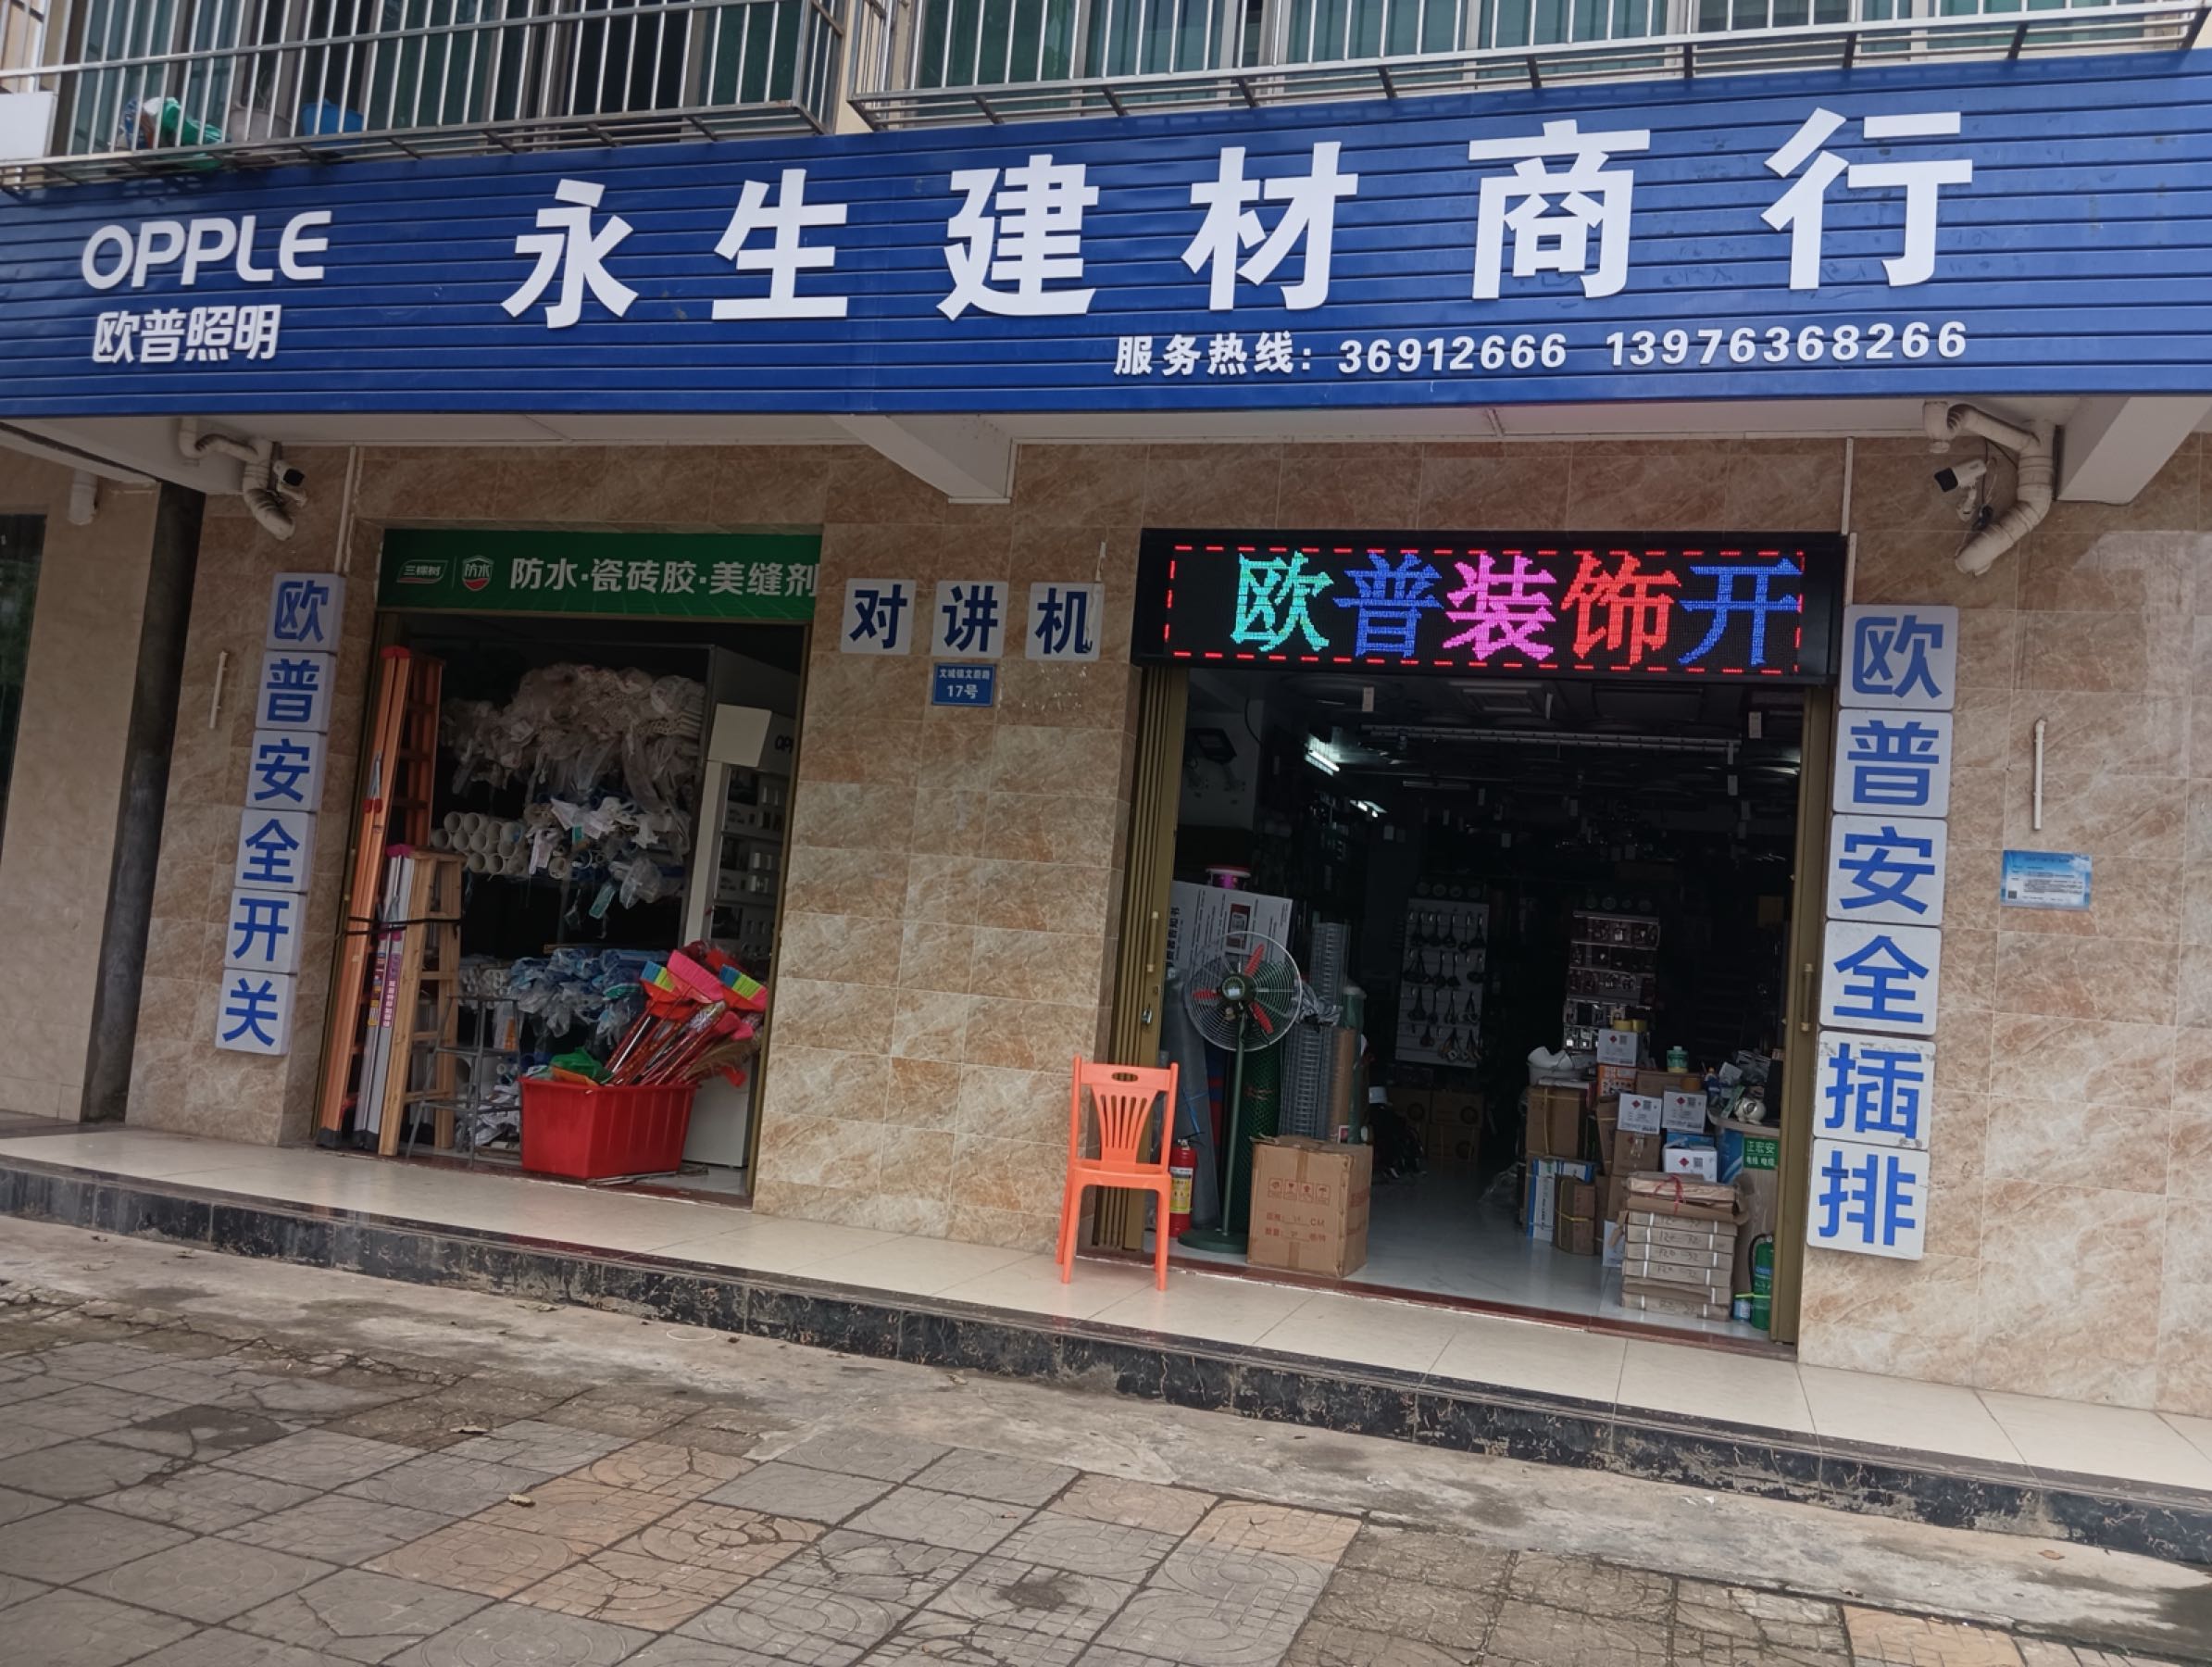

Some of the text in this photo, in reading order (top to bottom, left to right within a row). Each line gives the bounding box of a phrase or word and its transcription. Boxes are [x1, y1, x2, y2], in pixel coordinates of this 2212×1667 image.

[81, 210, 331, 290] OPPLE
[501, 107, 1972, 329] 永生建材商行
[93, 305, 281, 363] 欧普照明
[1339, 333, 1567, 373] 36912666
[1606, 321, 1967, 366] 13976368266
[464, 562, 491, 578] 防水
[850, 583, 1093, 654] 对讲机
[1230, 551, 1802, 665] 欧普装饰开
[947, 683, 979, 699] 17号
[222, 580, 329, 1047] 欧普安全开关
[1818, 614, 1944, 1247] 欧普安全插排
